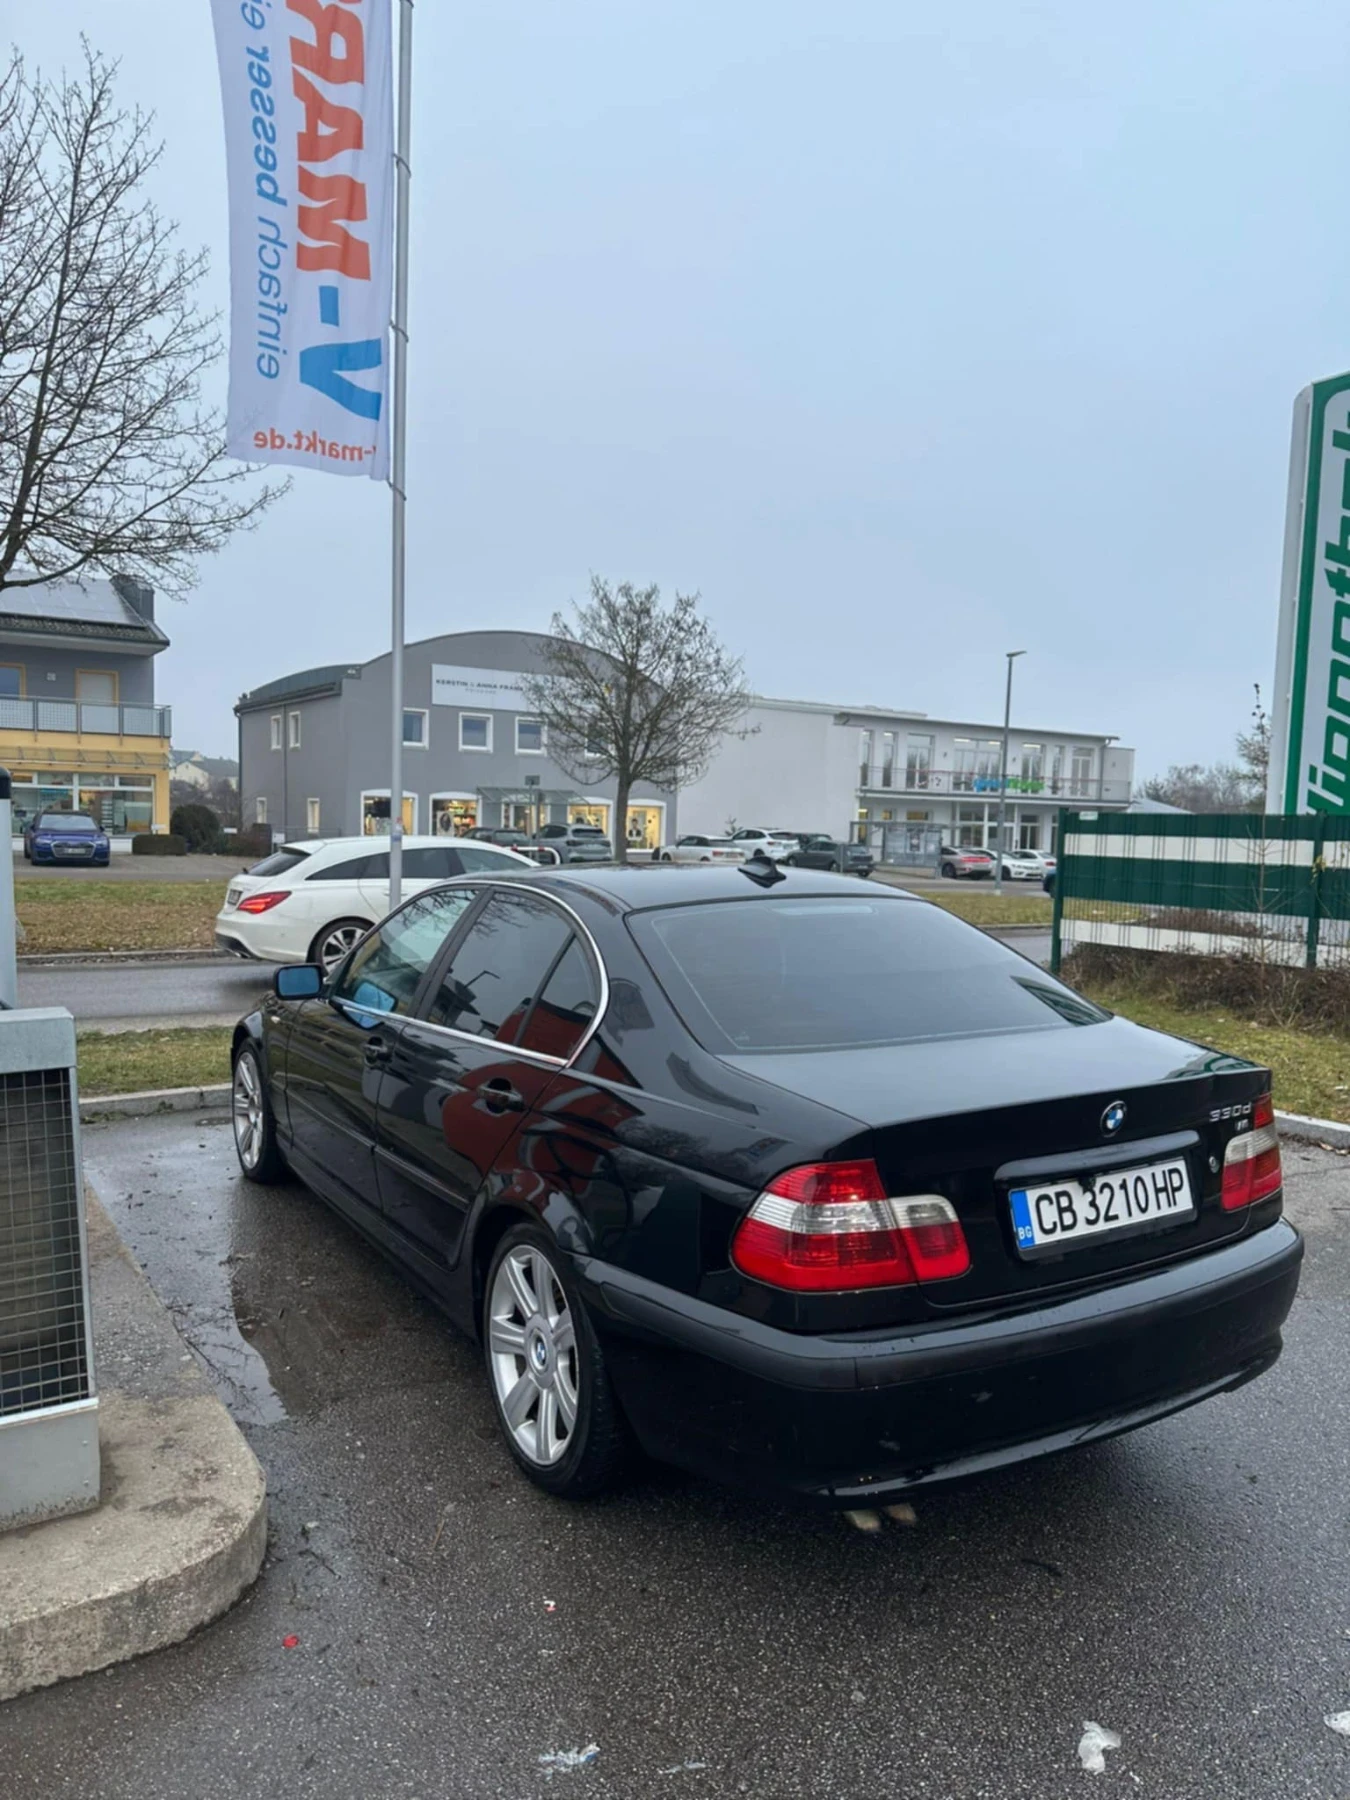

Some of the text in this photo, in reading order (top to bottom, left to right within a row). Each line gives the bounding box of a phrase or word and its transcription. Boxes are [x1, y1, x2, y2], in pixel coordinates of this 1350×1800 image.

[1209, 1101, 1252, 1122] 330d
[1035, 1167, 1184, 1235] CB 3210 HP
[1017, 1226, 1033, 1240] BG
